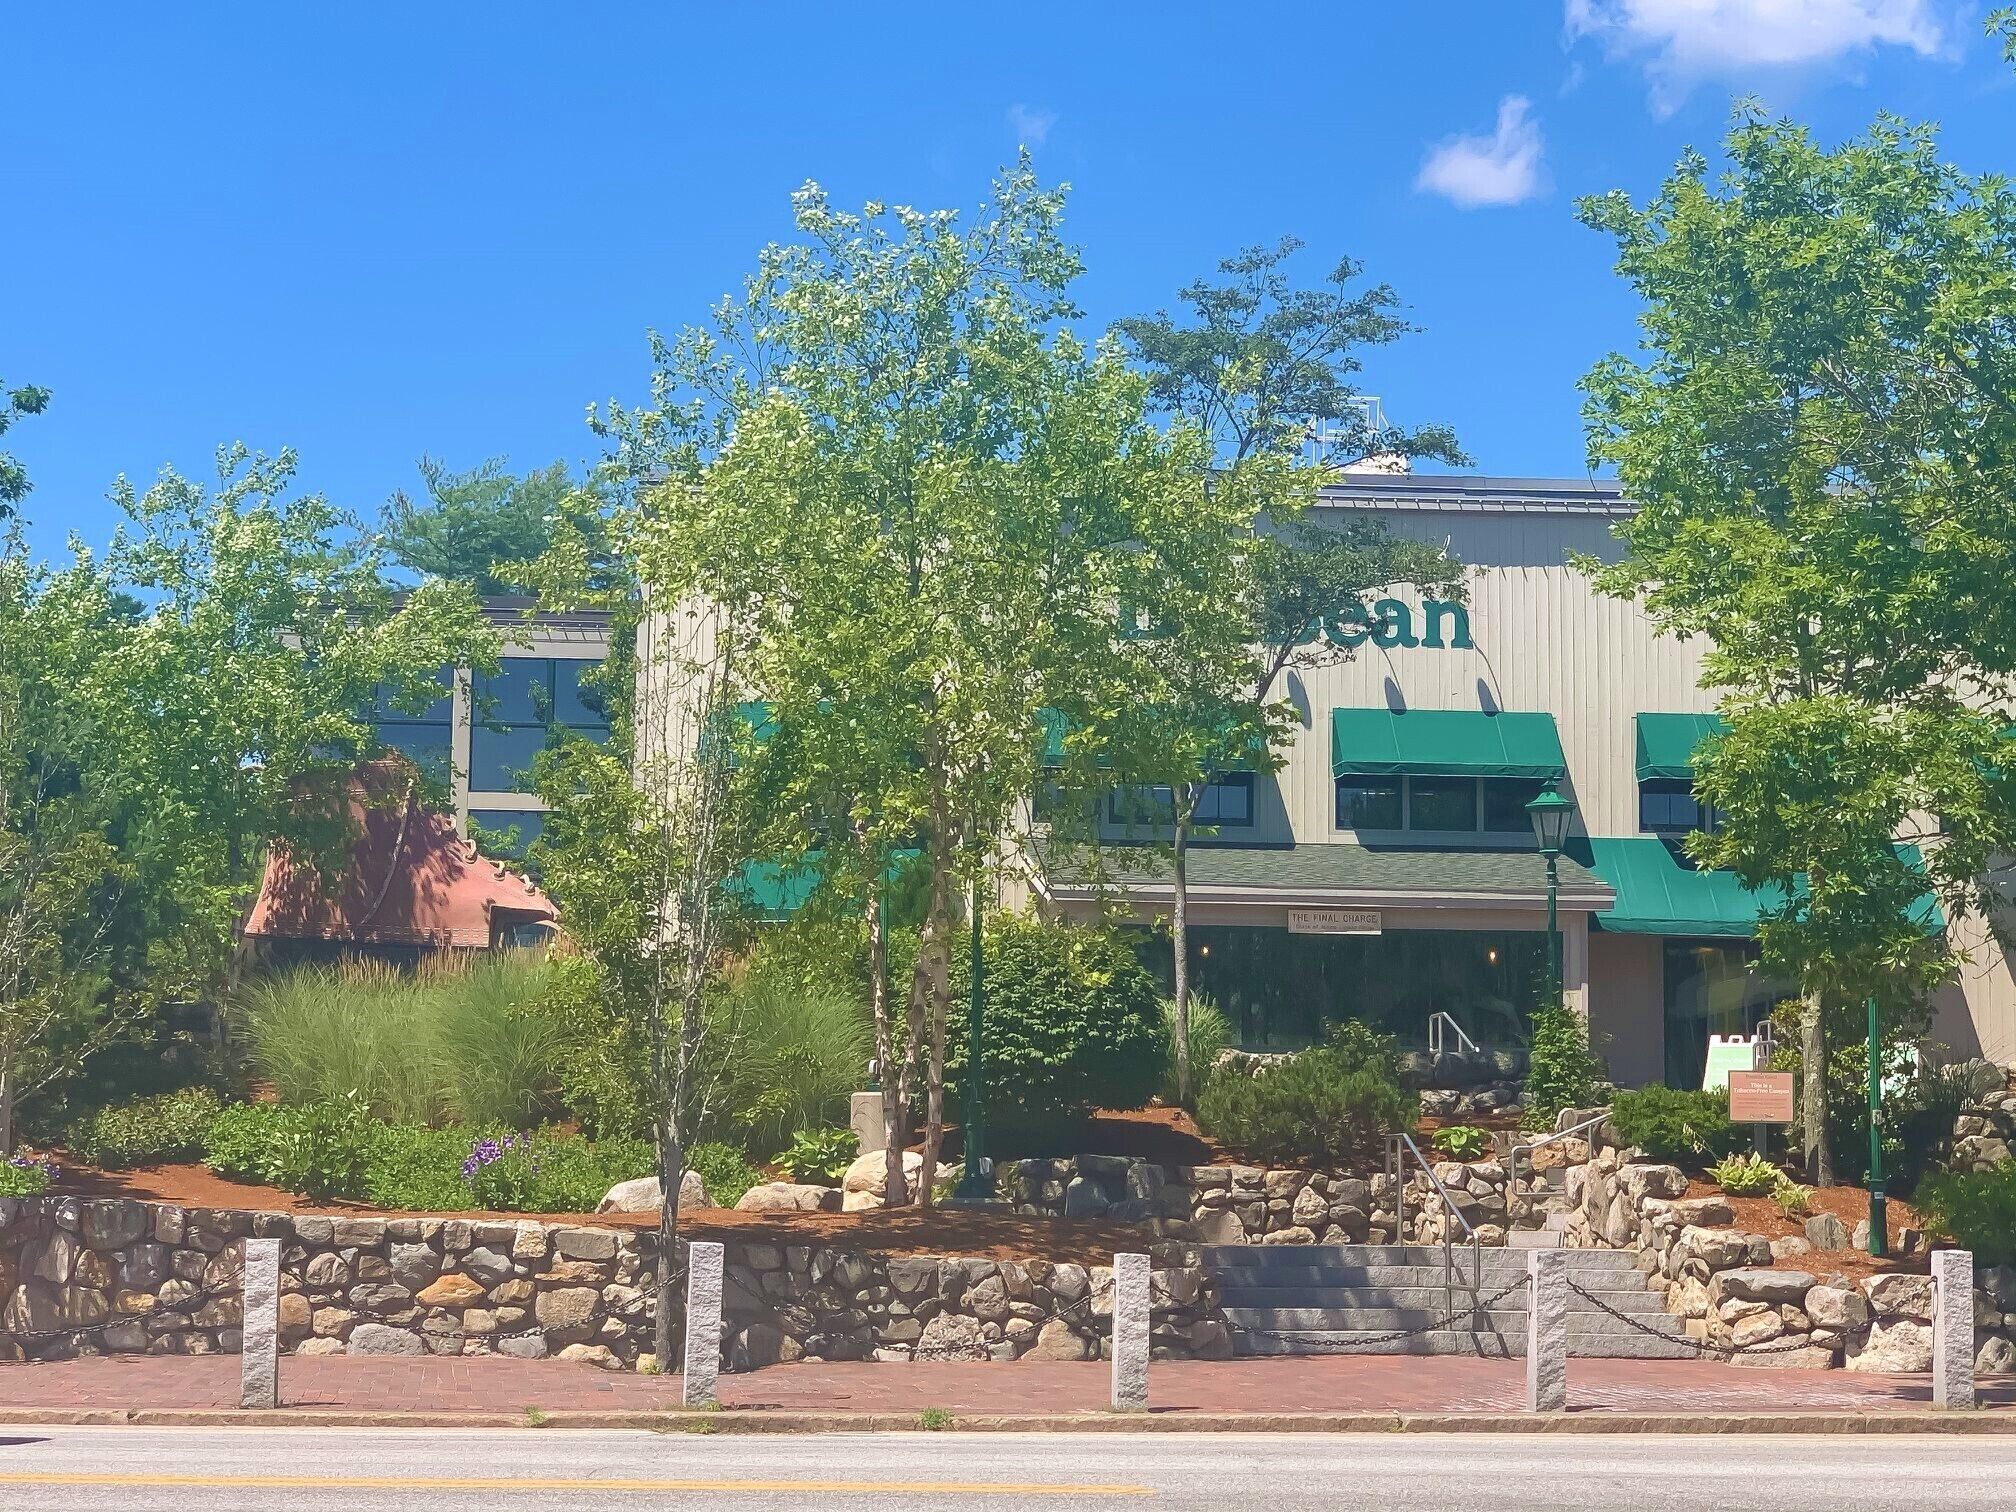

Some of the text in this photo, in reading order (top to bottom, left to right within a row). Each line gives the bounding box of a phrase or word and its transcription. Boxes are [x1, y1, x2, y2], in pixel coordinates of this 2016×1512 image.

[1293, 913, 1377, 924] THE FINAL CHARGE
